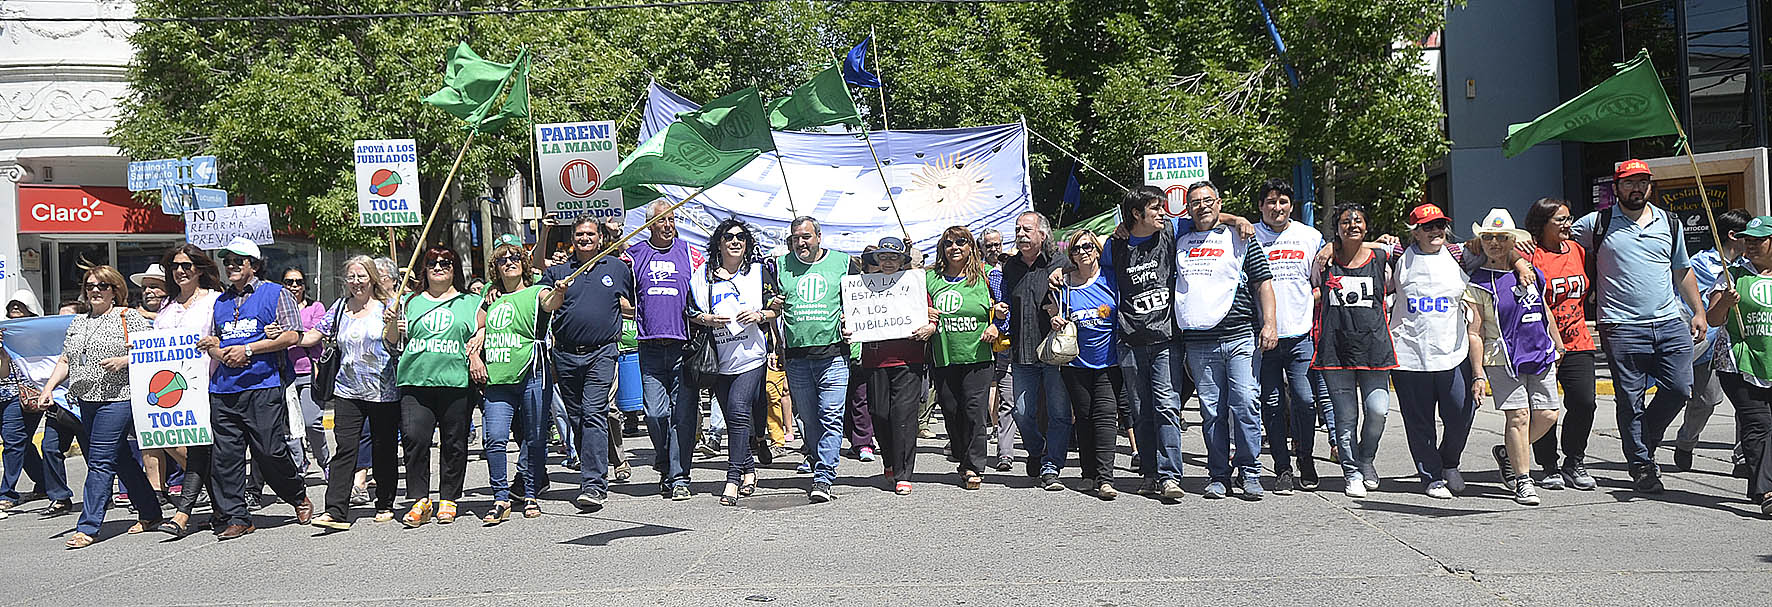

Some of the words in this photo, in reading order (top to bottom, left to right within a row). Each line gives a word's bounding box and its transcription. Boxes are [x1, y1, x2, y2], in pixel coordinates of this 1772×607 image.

[541, 124, 609, 142] PAREN!
[357, 145, 384, 153] APOYA
[396, 144, 414, 152] LOS
[541, 144, 561, 154] LA
[565, 140, 612, 153] MANO
[357, 153, 415, 163] JUBILADOS
[1148, 156, 1202, 170] PAREN!
[1148, 171, 1163, 180] LA
[1167, 169, 1204, 179] MANO
[1662, 188, 1727, 204] Restaant
[369, 199, 408, 210] TOCA
[556, 200, 582, 210] CON
[586, 199, 609, 208] LOS
[32, 203, 92, 221] Claro
[193, 211, 216, 222] NO
[231, 209, 238, 219] A
[362, 212, 419, 224] BOCINA
[192, 229, 273, 246] PREVISIONAL
[868, 279, 875, 287] A
[882, 277, 896, 286] LA
[851, 291, 895, 300] ESTAFA
[1133, 291, 1169, 311] CTEP
[1753, 282, 1772, 306] AT
[852, 307, 860, 316] A
[867, 305, 887, 314] LOS
[1407, 297, 1448, 313] CCC
[853, 316, 912, 332] JUBILADOS
[943, 317, 978, 331] NEGRO
[131, 338, 166, 350] APOYA
[169, 338, 176, 346] A
[180, 334, 200, 345] LOS
[409, 338, 426, 352] RIO
[427, 339, 459, 353] NEGRO
[131, 347, 203, 365] JUBILADOS
[148, 410, 197, 428] TOCA
[140, 427, 212, 447] BOCINA
